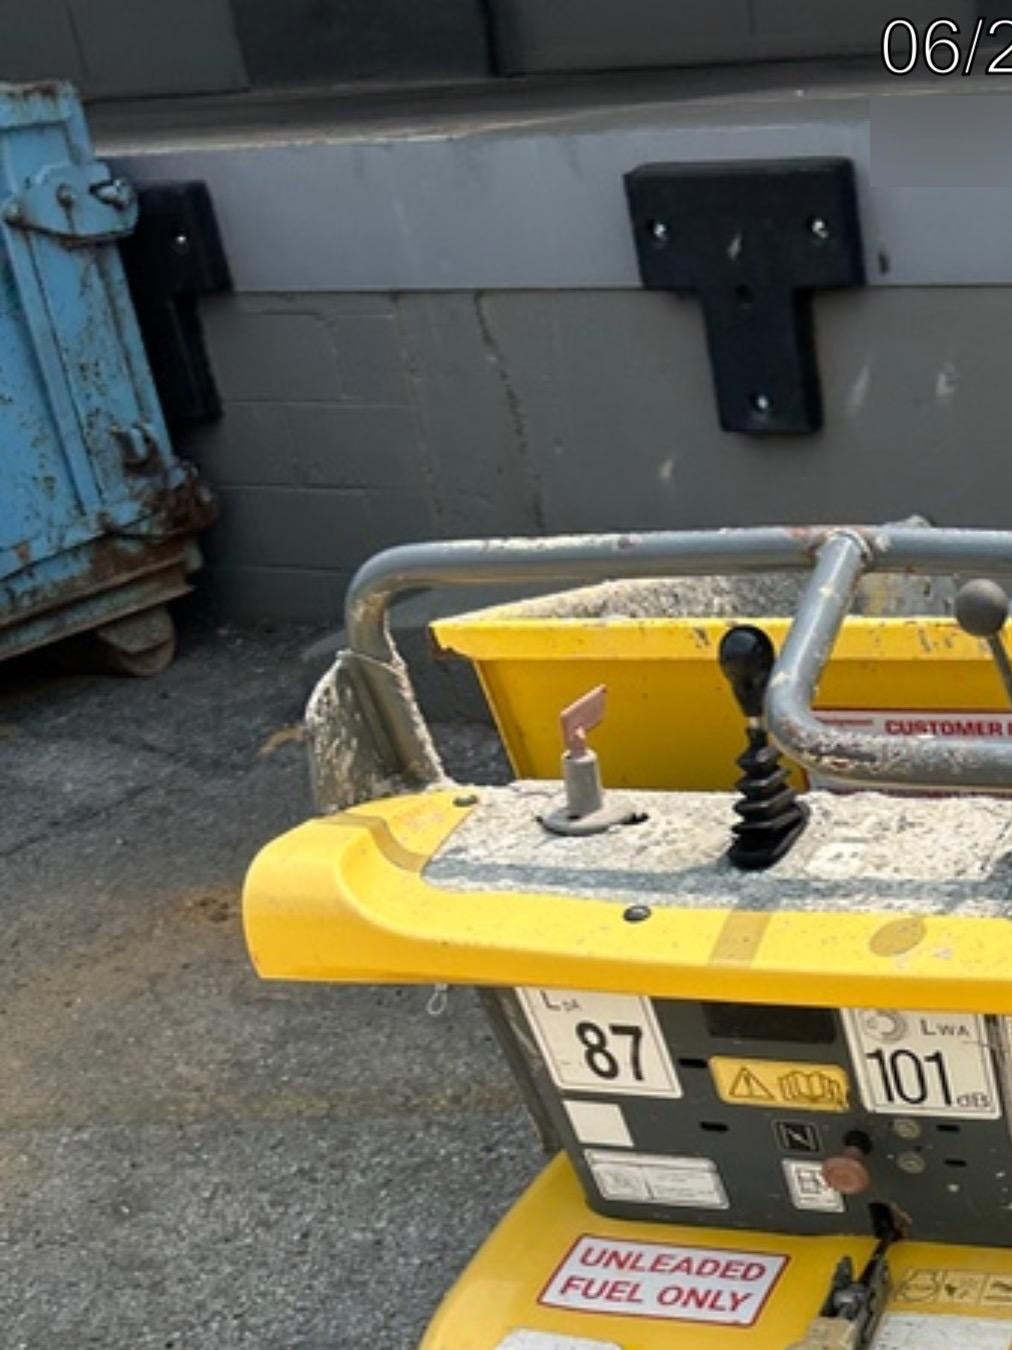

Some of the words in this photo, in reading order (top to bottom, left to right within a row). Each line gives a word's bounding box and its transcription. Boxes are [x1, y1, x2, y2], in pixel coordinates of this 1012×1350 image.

[884, 719, 1003, 736] CUSTOMER
[576, 1021, 644, 1081] 87
[865, 1048, 952, 1106] 101
[580, 1247, 767, 1282] UNLEADED
[560, 1275, 643, 1304] FUEL
[657, 1285, 753, 1312] ONLY
